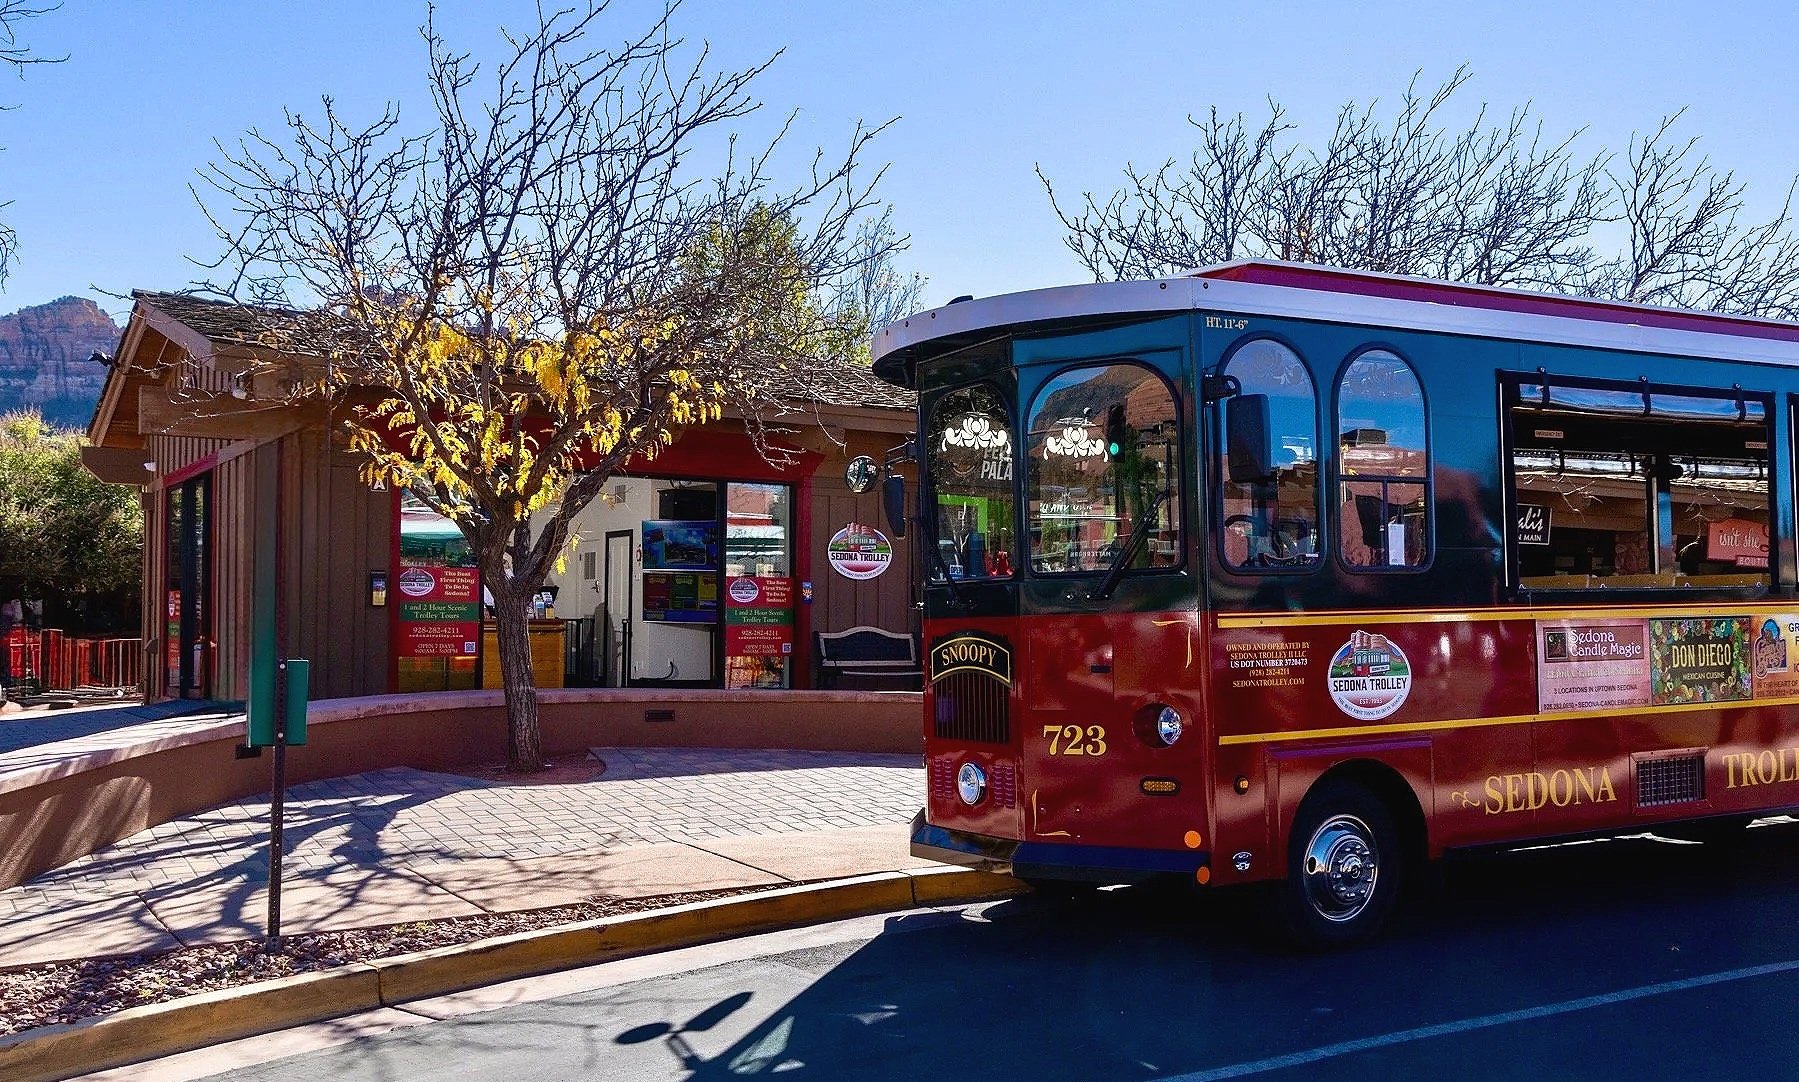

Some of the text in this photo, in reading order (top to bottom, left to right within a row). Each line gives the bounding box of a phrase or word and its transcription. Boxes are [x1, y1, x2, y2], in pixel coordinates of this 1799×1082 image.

[1206, 316, 1222, 328] HT.
[831, 552, 890, 562] SEDONA TROLLEY
[1570, 628, 1615, 644] Sedona
[1226, 643, 1252, 652] OWNED
[1252, 643, 1267, 651] AND
[1267, 642, 1300, 650] OPERATED
[1570, 642, 1641, 658] Candle Magic
[941, 644, 997, 667] SNOOPY
[1230, 652, 1258, 660] SEDONA
[1258, 651, 1287, 659] TROLLEY
[1672, 644, 1695, 668] DON
[1698, 643, 1731, 668] DIEGO
[1256, 659, 1284, 667] NUMBER
[1232, 678, 1305, 688] SEDONATROLLEY.COM
[1333, 678, 1408, 692] SEDONA TROLLEY
[1558, 686, 1588, 694] LOCATIONS
[1043, 724, 1107, 756] 723
[1484, 766, 1617, 816] SEDONA
